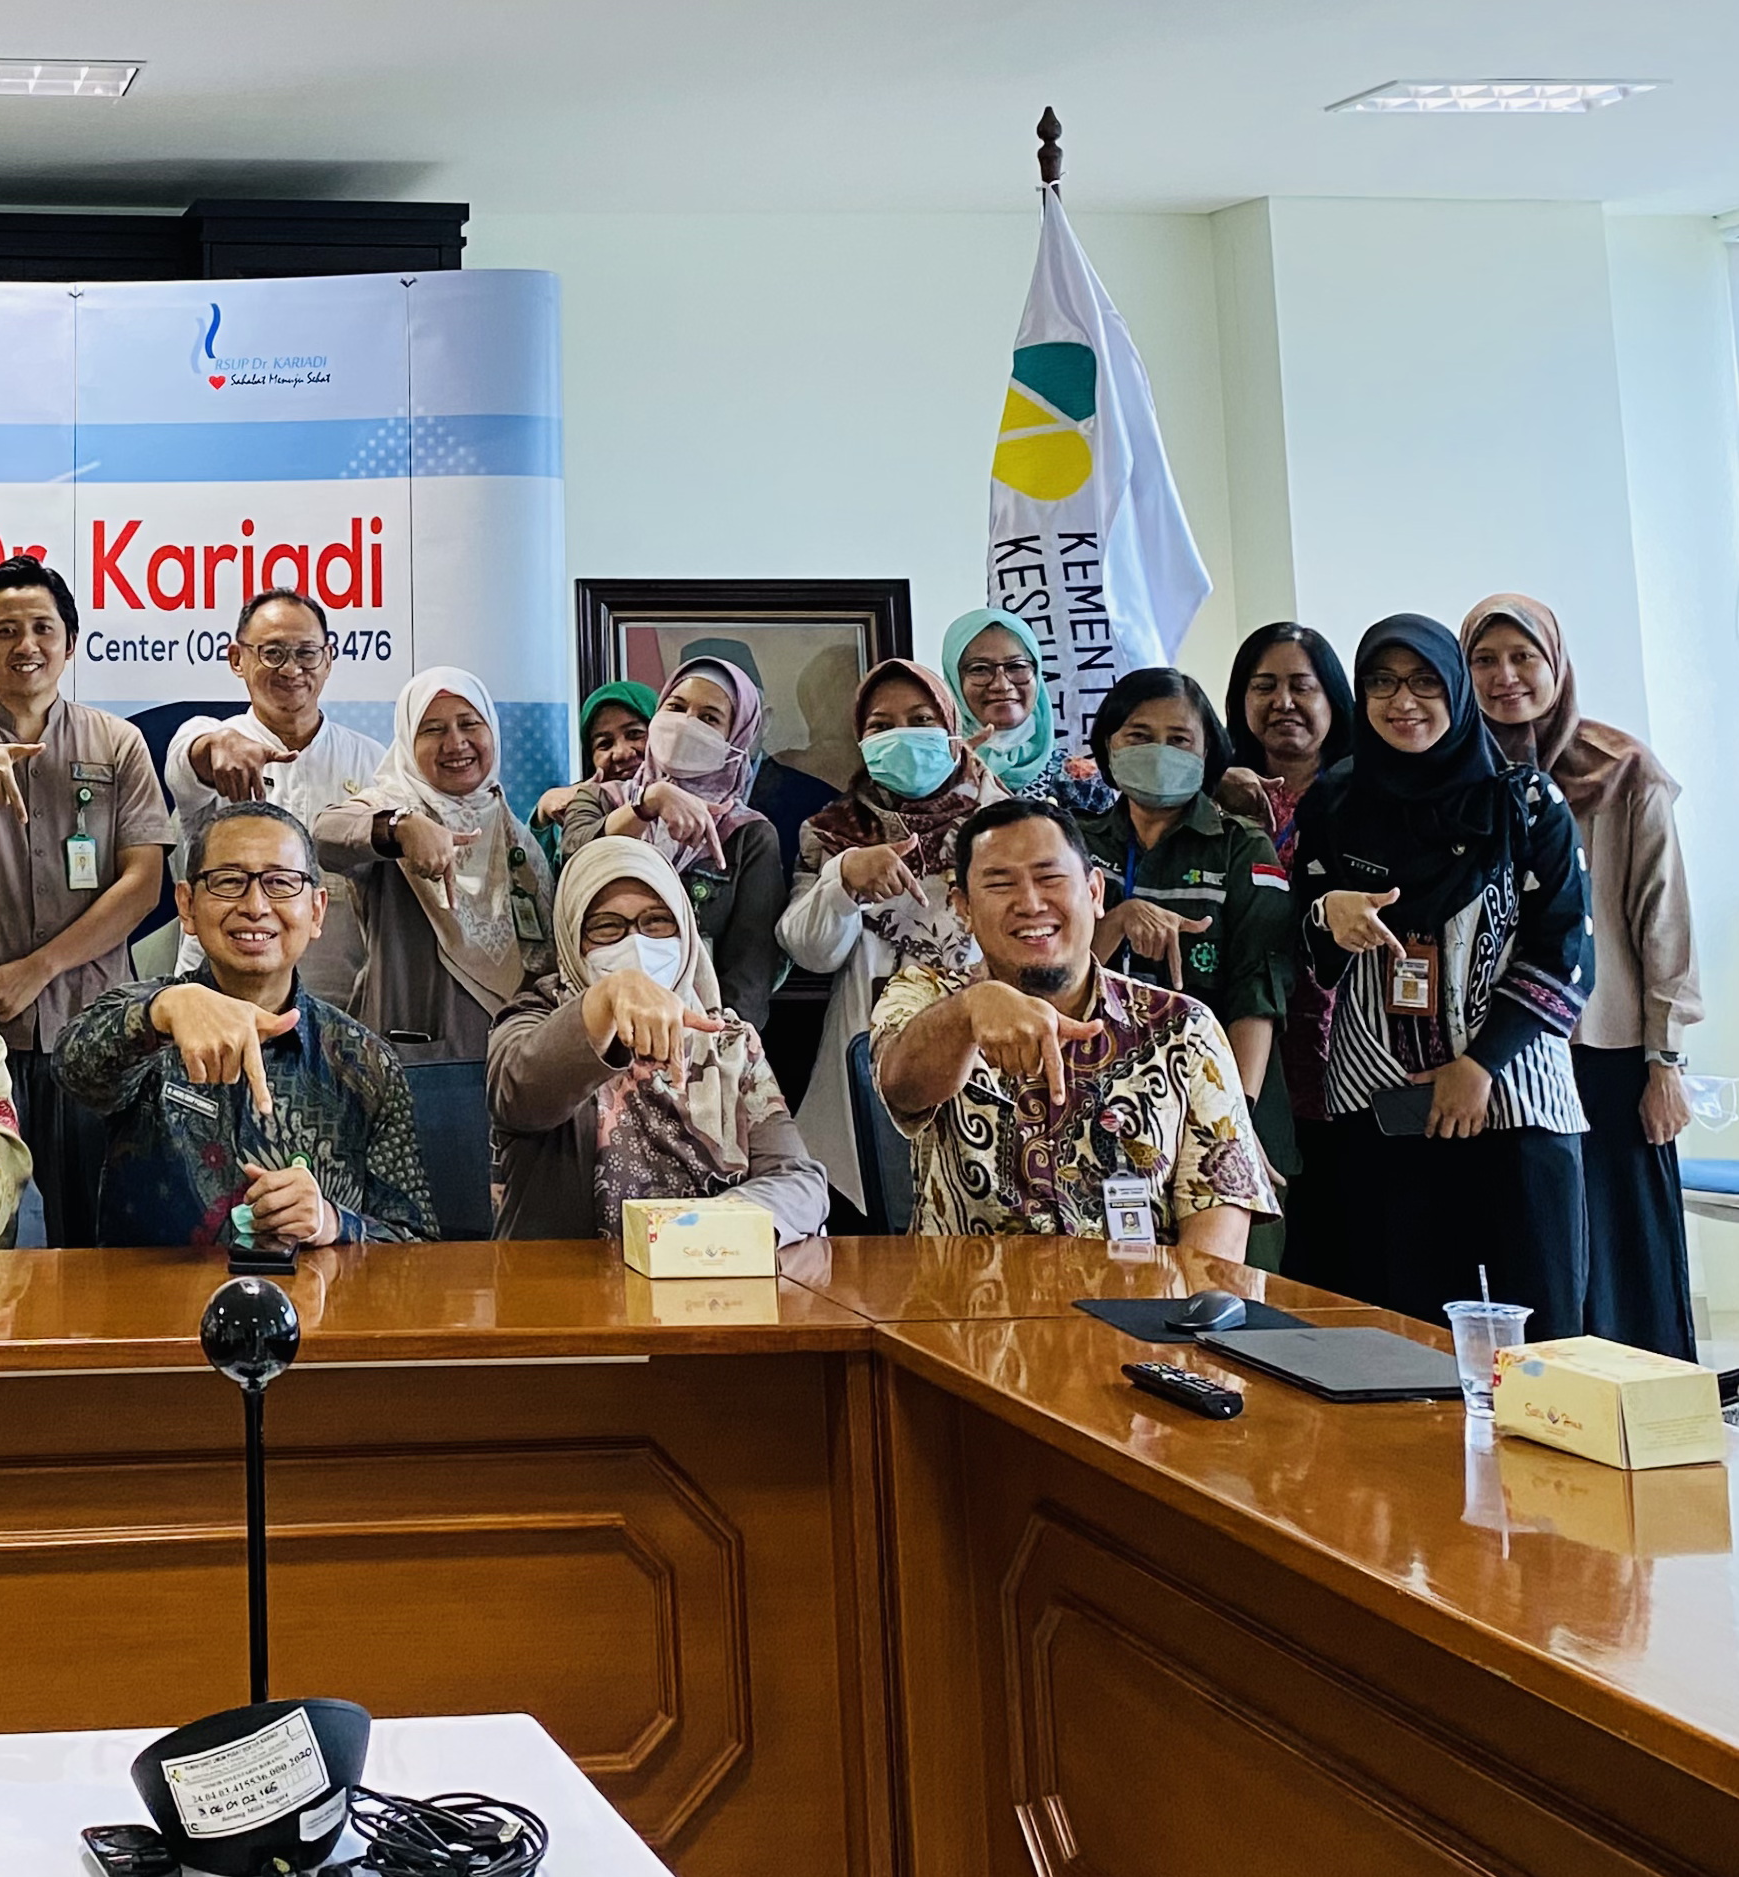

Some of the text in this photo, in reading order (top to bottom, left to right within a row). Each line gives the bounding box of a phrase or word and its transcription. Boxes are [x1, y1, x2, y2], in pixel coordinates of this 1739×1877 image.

[215, 358, 249, 370] RSUP
[273, 356, 327, 369] KARIADI
[231, 371, 331, 388] Sahabat Menuju Sehat
[92, 516, 383, 611] Kariadi
[86, 631, 179, 662] Center
[187, 629, 232, 665] (02
